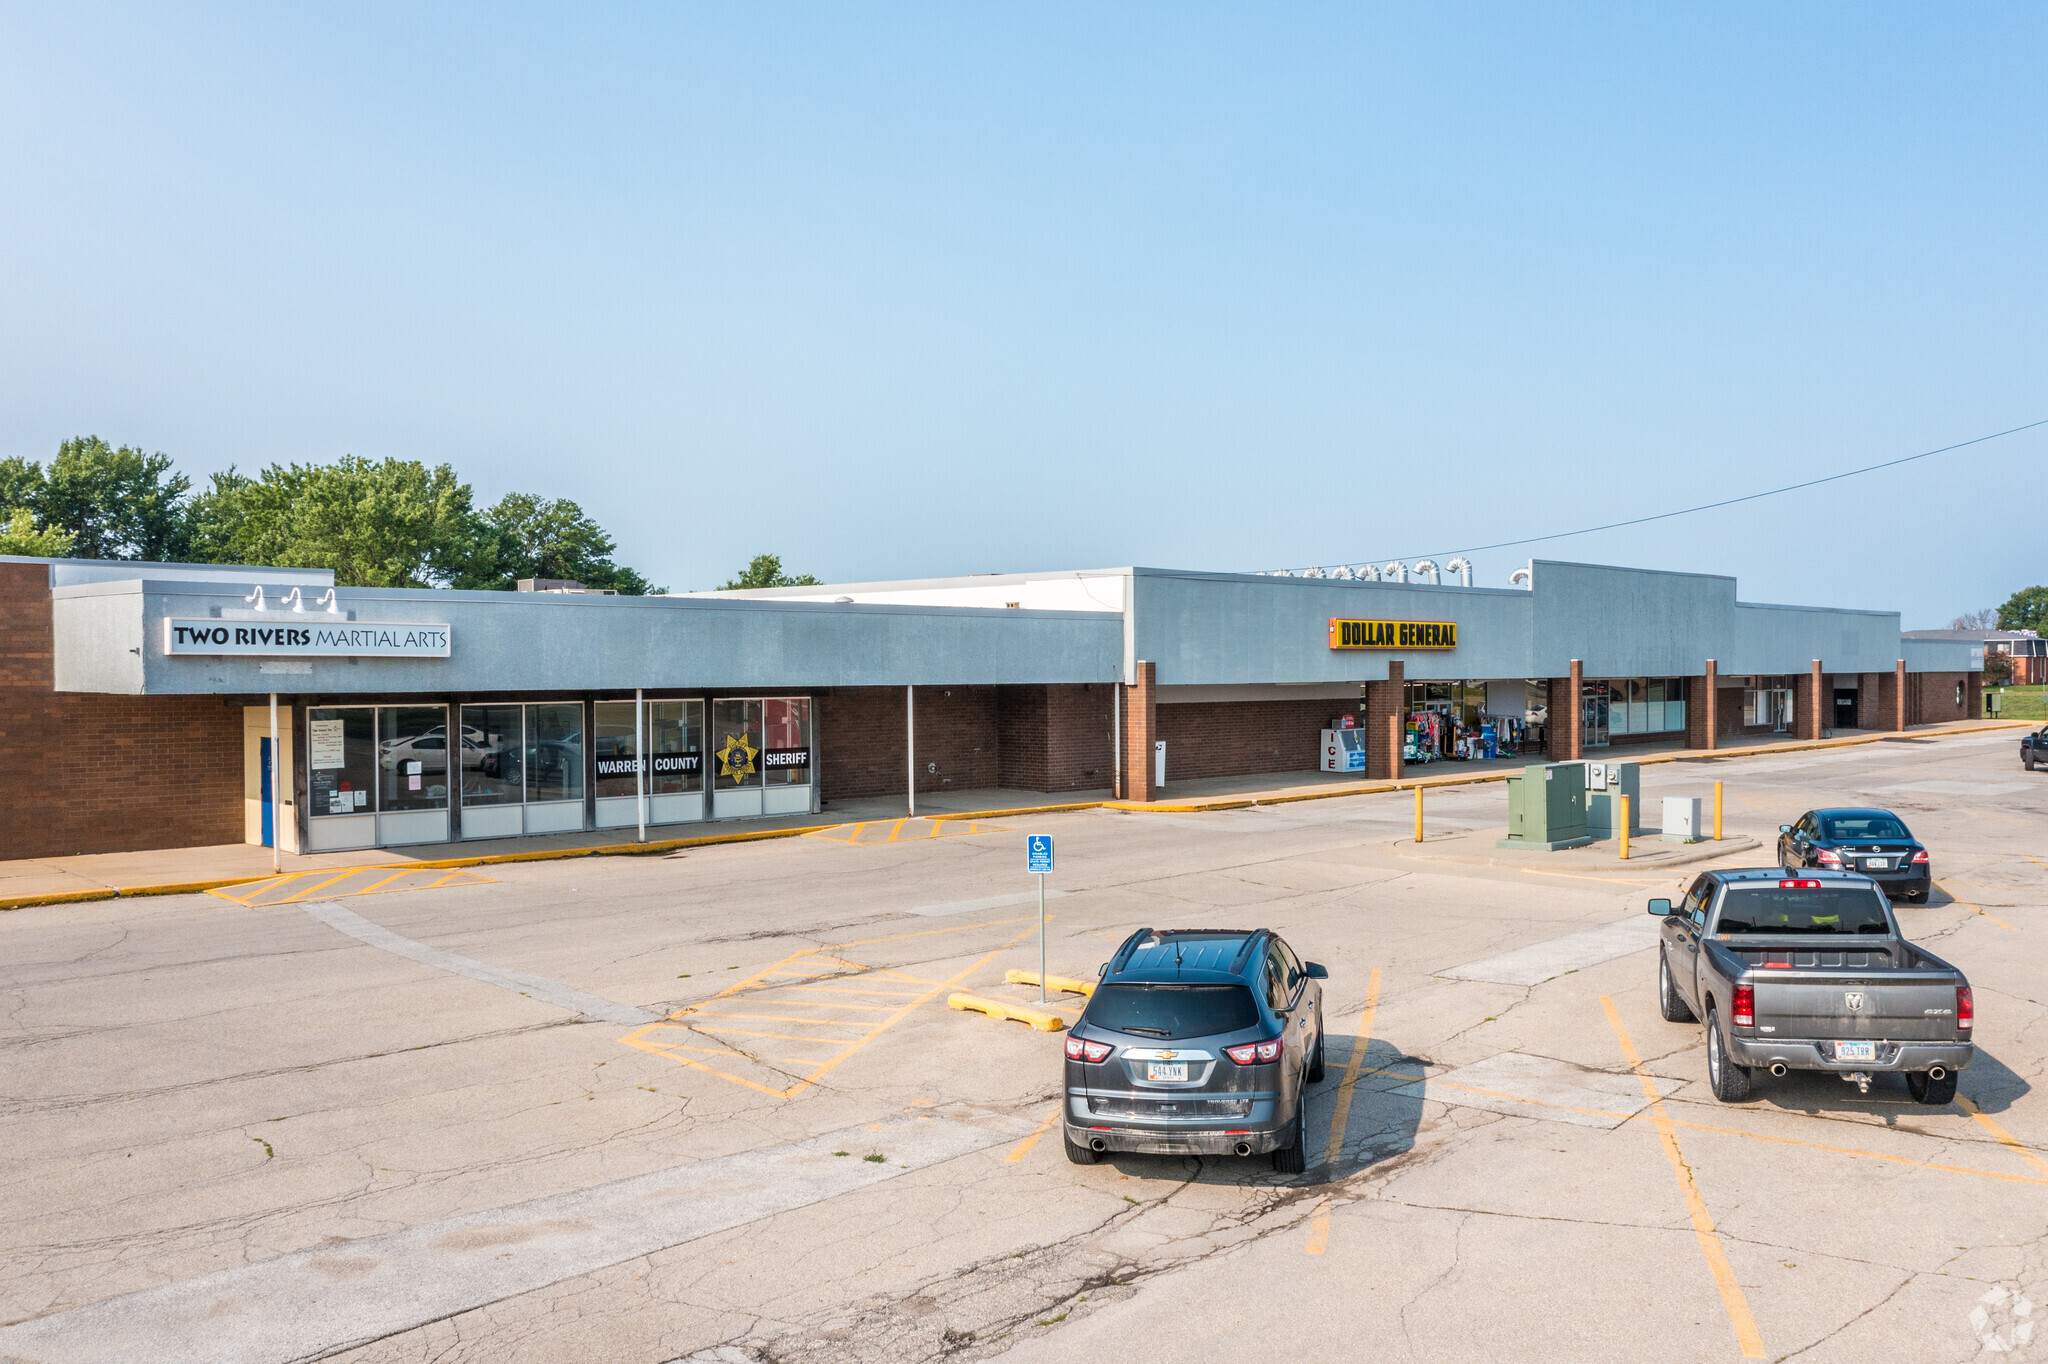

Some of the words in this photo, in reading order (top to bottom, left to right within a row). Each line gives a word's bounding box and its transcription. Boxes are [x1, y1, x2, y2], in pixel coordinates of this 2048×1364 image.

[173, 626, 230, 646] TWO
[235, 628, 311, 647] RIVERS
[315, 629, 401, 648] MARTIAL
[403, 631, 447, 648] ARTS
[1341, 621, 1395, 646] DOLLAR
[1399, 623, 1456, 646] GENERAL
[1327, 733, 1336, 769] ICE
[597, 759, 647, 774] WARREN
[654, 756, 699, 771] COUNTY
[766, 752, 808, 766] SHERIFF
[1841, 1046, 1854, 1056] 925
[1152, 1066, 1167, 1076] 544
[1168, 1066, 1182, 1076] YNK
